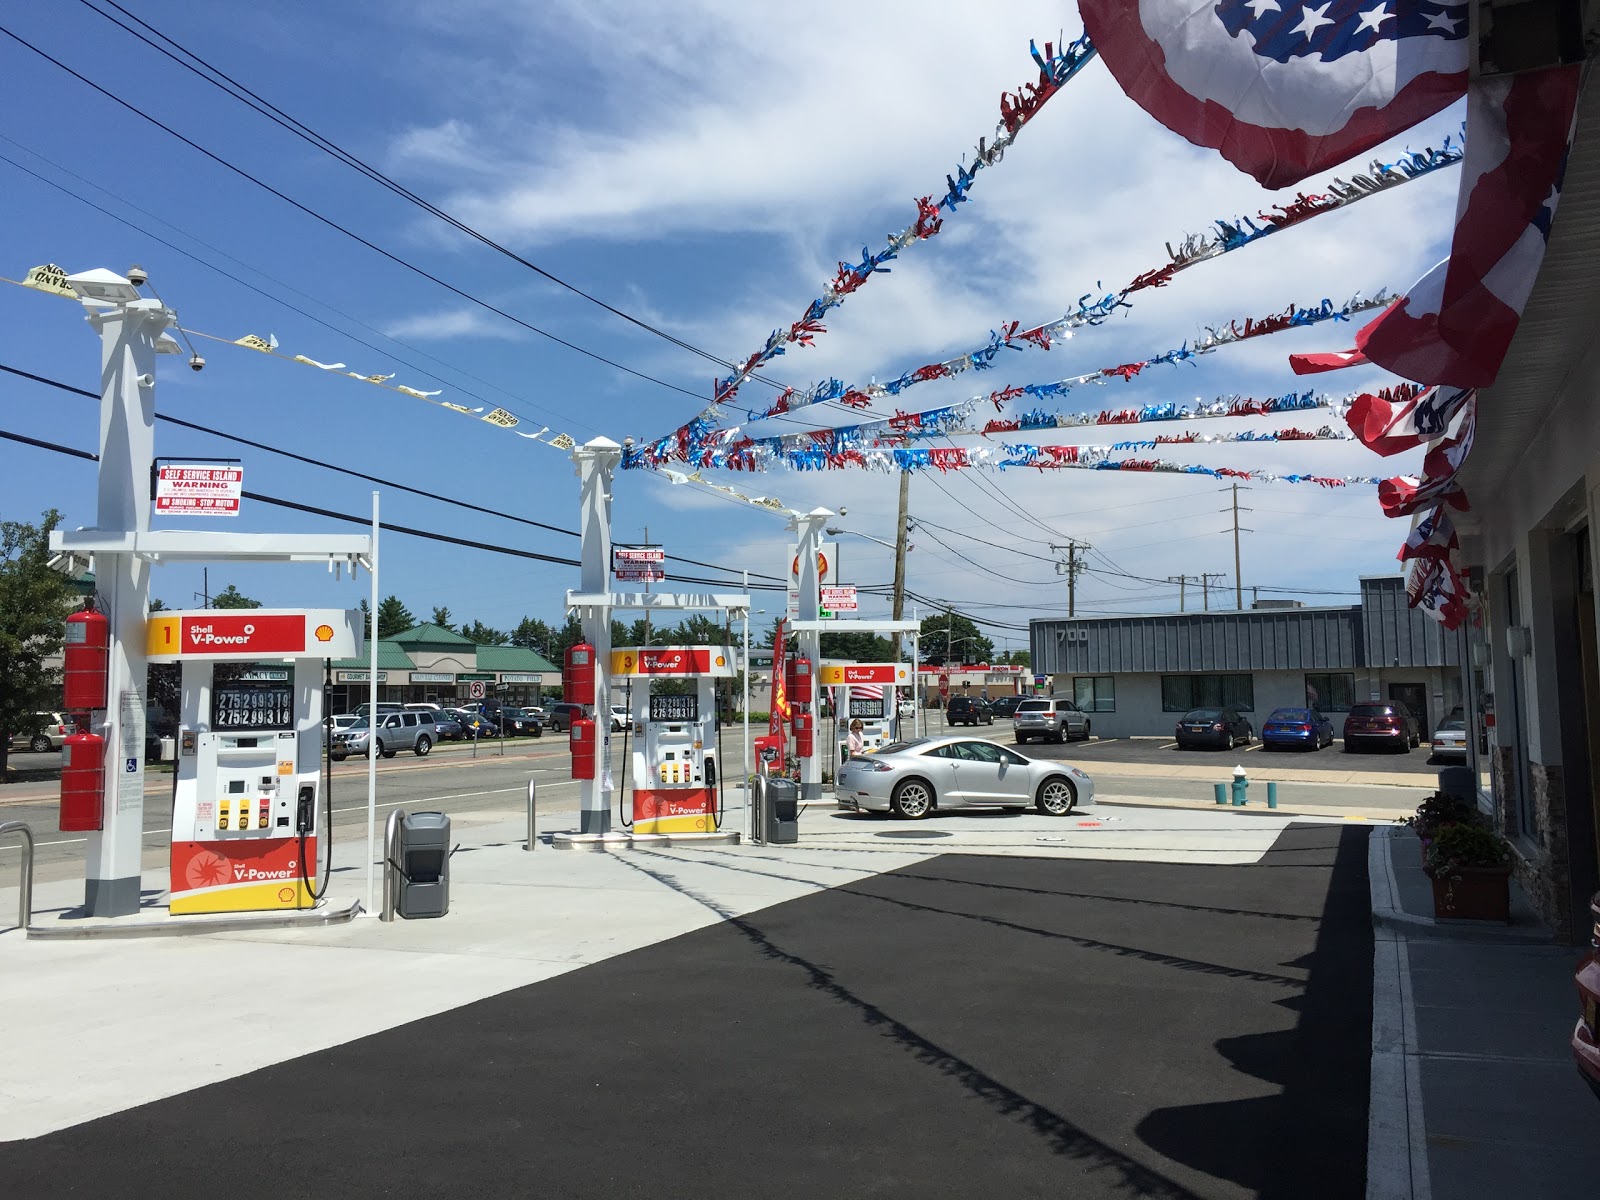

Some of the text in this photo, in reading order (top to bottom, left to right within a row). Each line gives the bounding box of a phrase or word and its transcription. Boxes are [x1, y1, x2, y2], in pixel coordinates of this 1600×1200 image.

[164, 470, 238, 481] SELF SERVICE ISLAND
[164, 626, 170, 644] 1
[190, 625, 213, 634] Shell
[1056, 628, 1088, 641] 700
[190, 634, 250, 644] V-Power
[624, 656, 632, 668] 3
[834, 671, 840, 679] 5
[234, 868, 293, 880] V-Power
